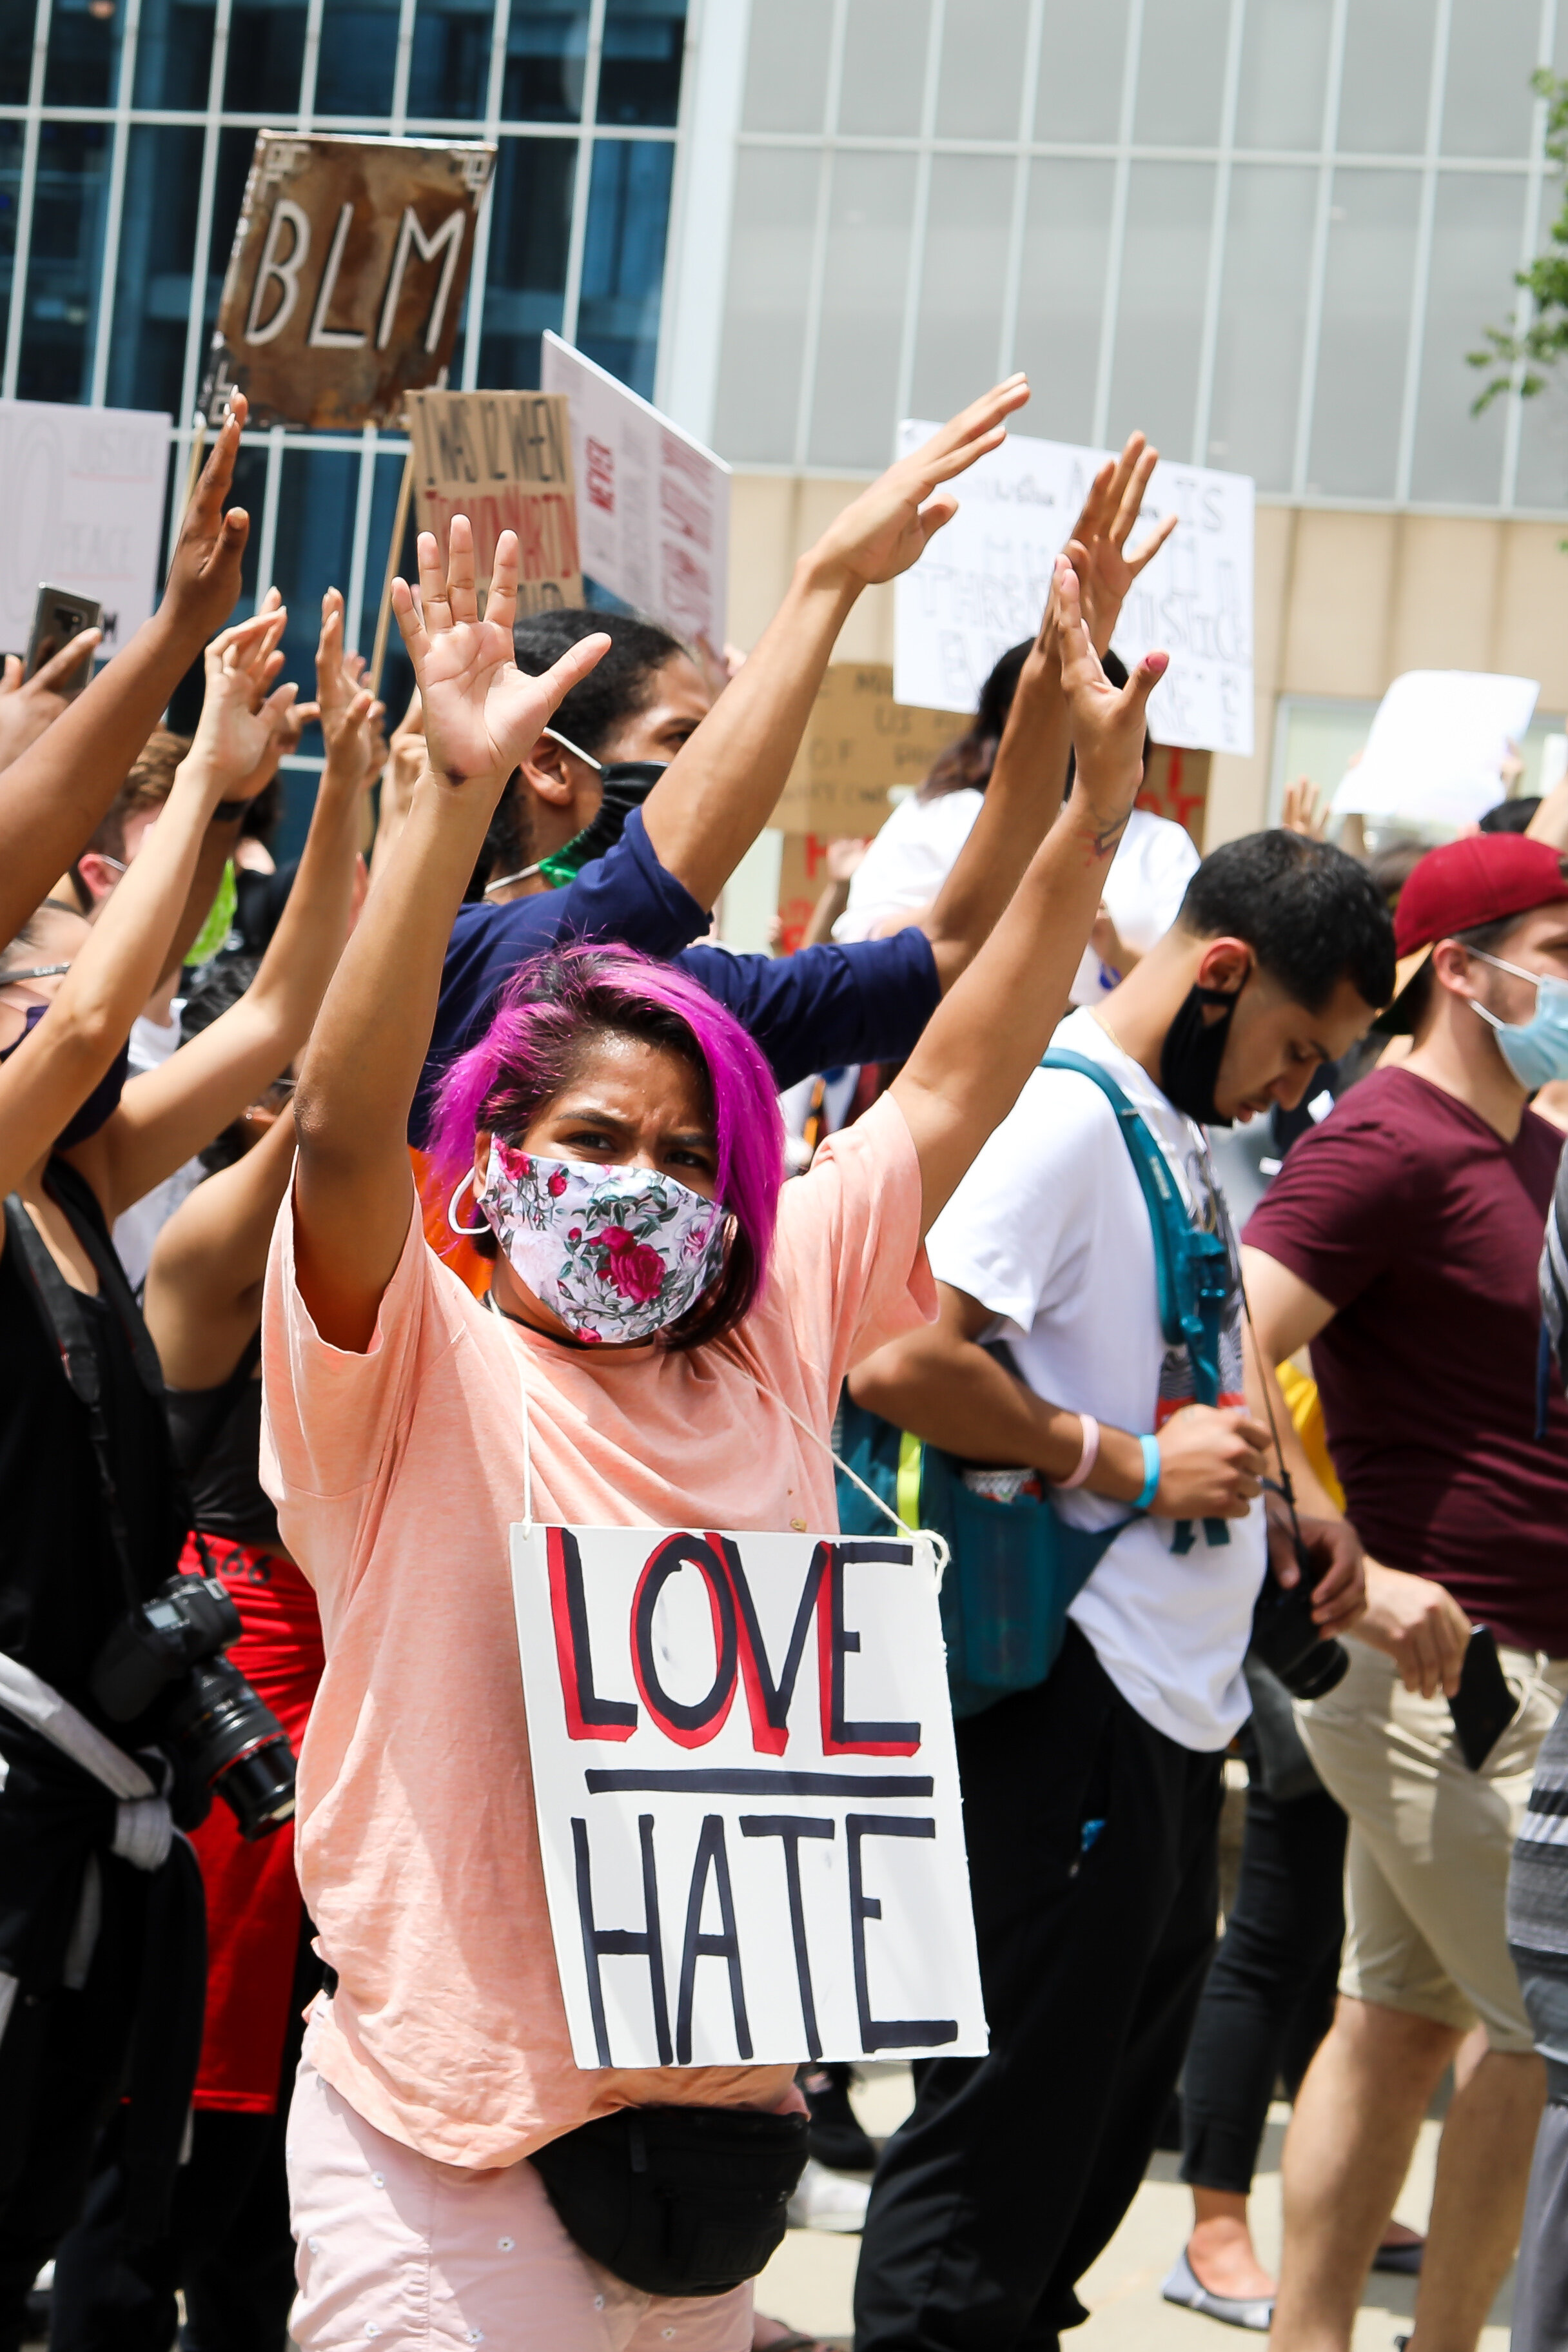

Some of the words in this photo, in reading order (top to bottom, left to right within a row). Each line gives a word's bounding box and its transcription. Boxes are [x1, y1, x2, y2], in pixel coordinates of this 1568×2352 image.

[245, 199, 467, 353] BLM
[417, 396, 436, 485] I
[431, 398, 478, 484] WAS
[504, 398, 567, 483] WHEN
[1173, 475, 1224, 534] IS
[545, 1527, 922, 1758] LOVE
[570, 1812, 958, 2068] HATE
